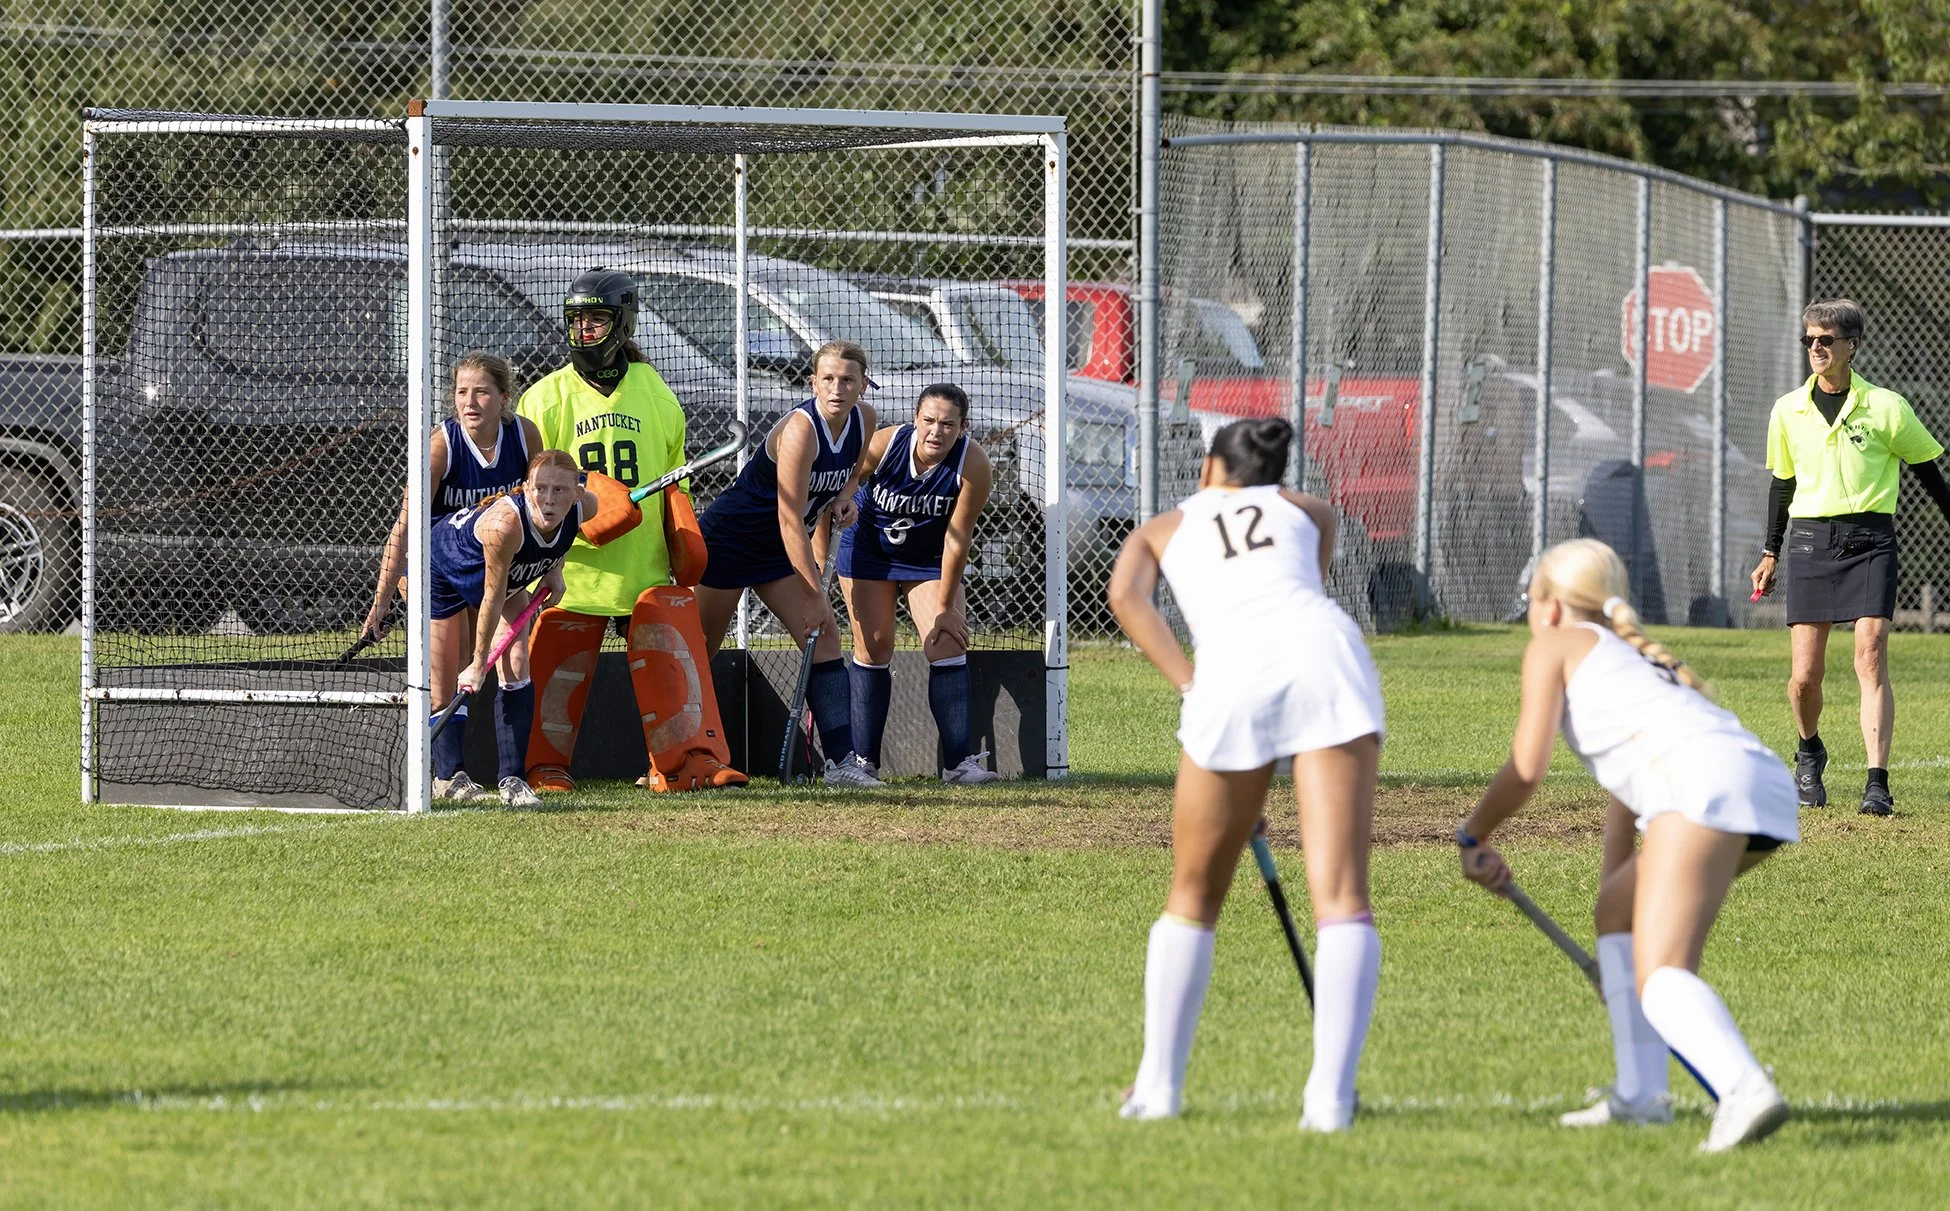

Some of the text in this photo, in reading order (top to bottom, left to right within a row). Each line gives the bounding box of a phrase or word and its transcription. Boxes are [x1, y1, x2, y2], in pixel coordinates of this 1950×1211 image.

[576, 412, 642, 437] NANTUCKET
[578, 440, 640, 488] 88
[660, 461, 694, 489] STX
[807, 468, 857, 492] ANTUCK
[872, 483, 955, 517] NANTUCKET
[1213, 505, 1275, 559] 12
